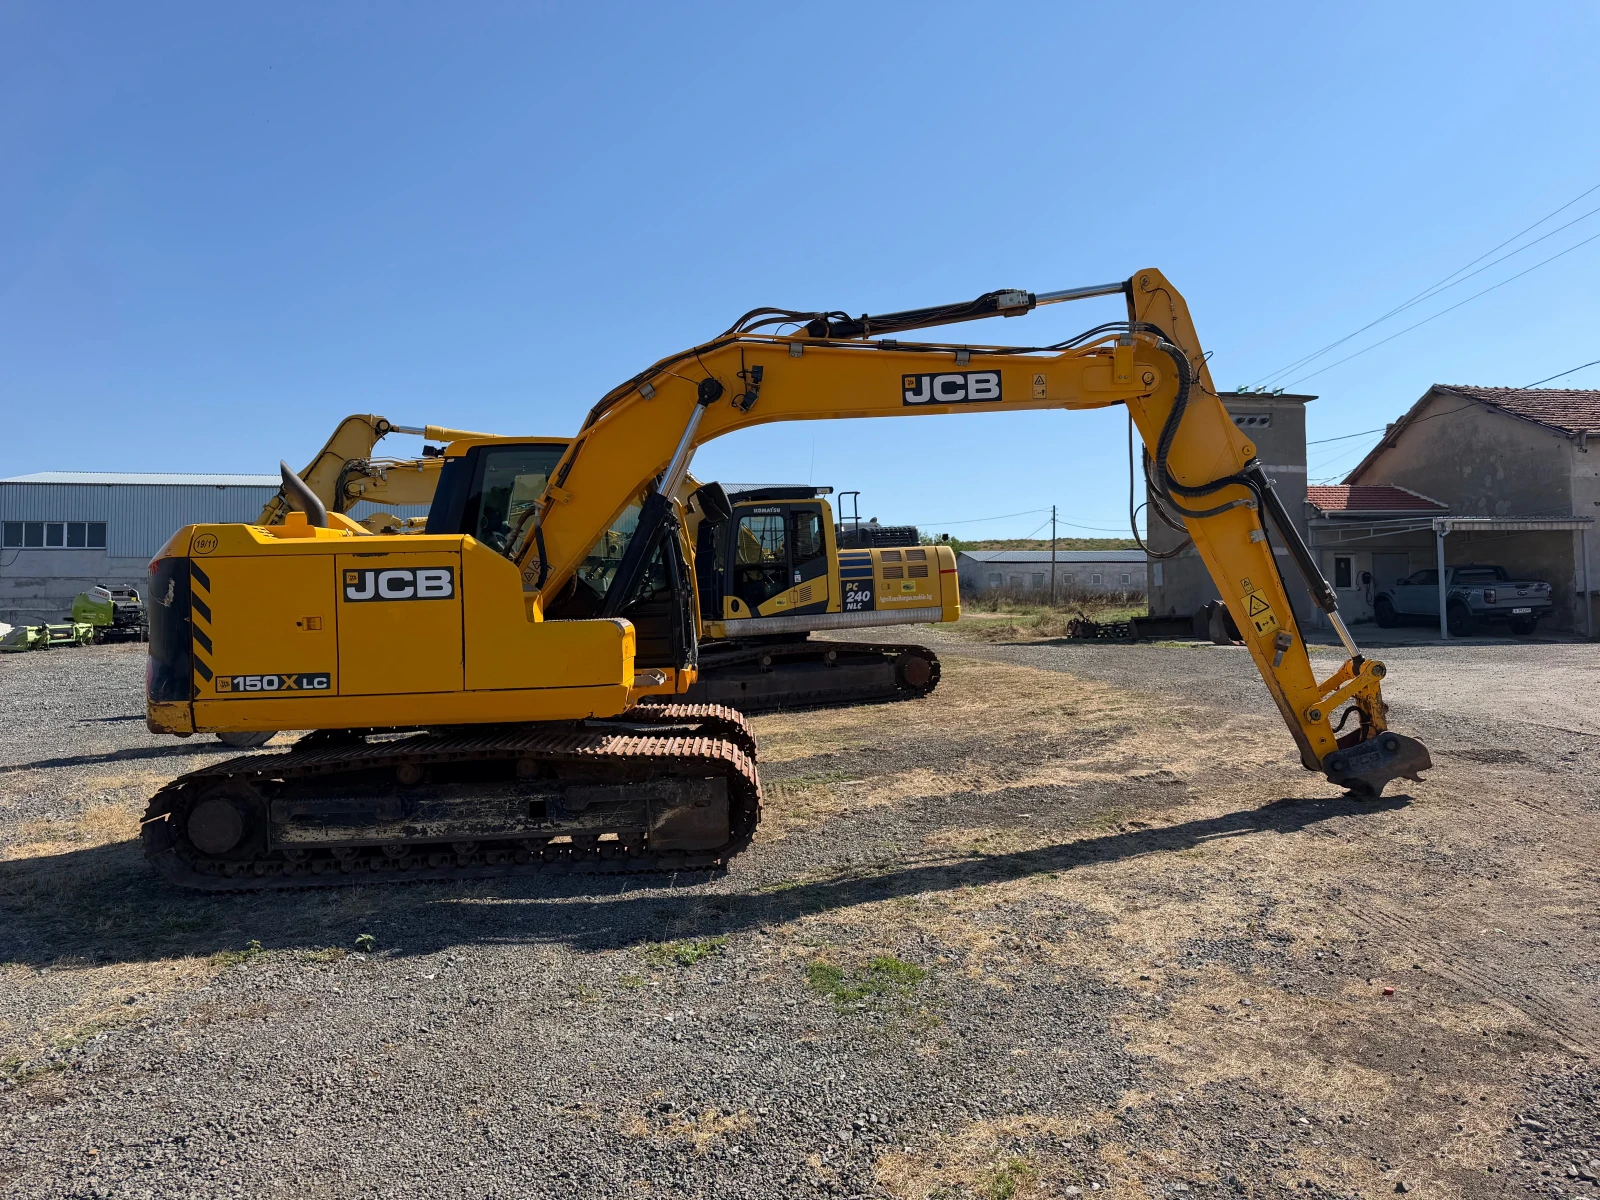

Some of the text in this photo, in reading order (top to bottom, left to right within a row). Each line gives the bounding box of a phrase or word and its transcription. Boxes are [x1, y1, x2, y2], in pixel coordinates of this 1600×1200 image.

[905, 372, 1000, 403] JCB
[196, 539, 216, 549] 19/11
[346, 569, 453, 600] JCB
[845, 582, 859, 591] PC
[845, 590, 871, 603] 240
[846, 602, 863, 610] NLC
[302, 677, 328, 689] LC
